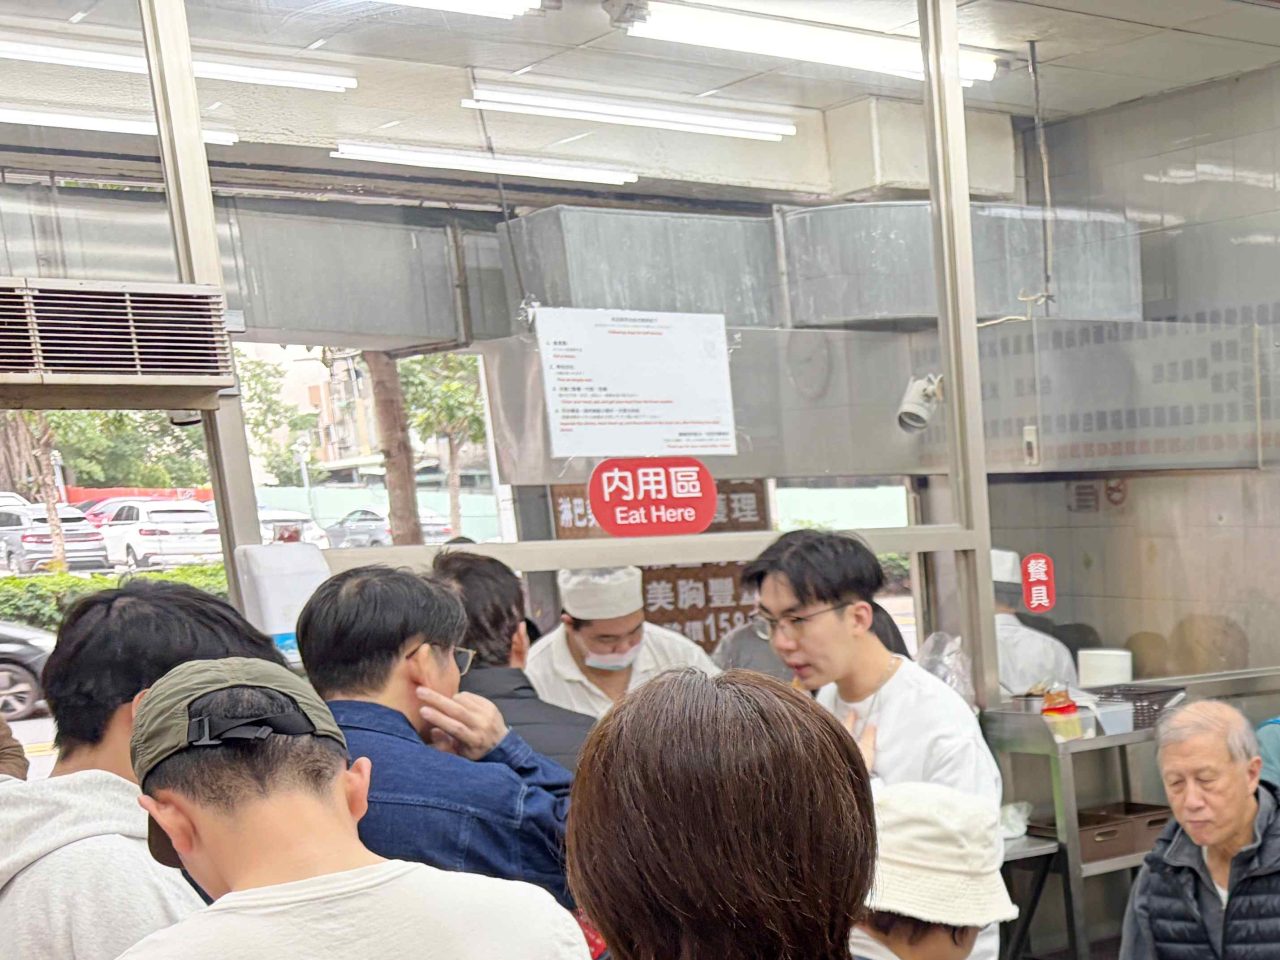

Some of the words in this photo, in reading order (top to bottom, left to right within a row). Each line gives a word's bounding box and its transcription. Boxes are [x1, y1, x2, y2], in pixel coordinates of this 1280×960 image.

[602, 467, 702, 502] 內用區
[615, 506, 648, 525] Eat
[651, 505, 695, 523] Here
[1027, 559, 1049, 608] 餐具
